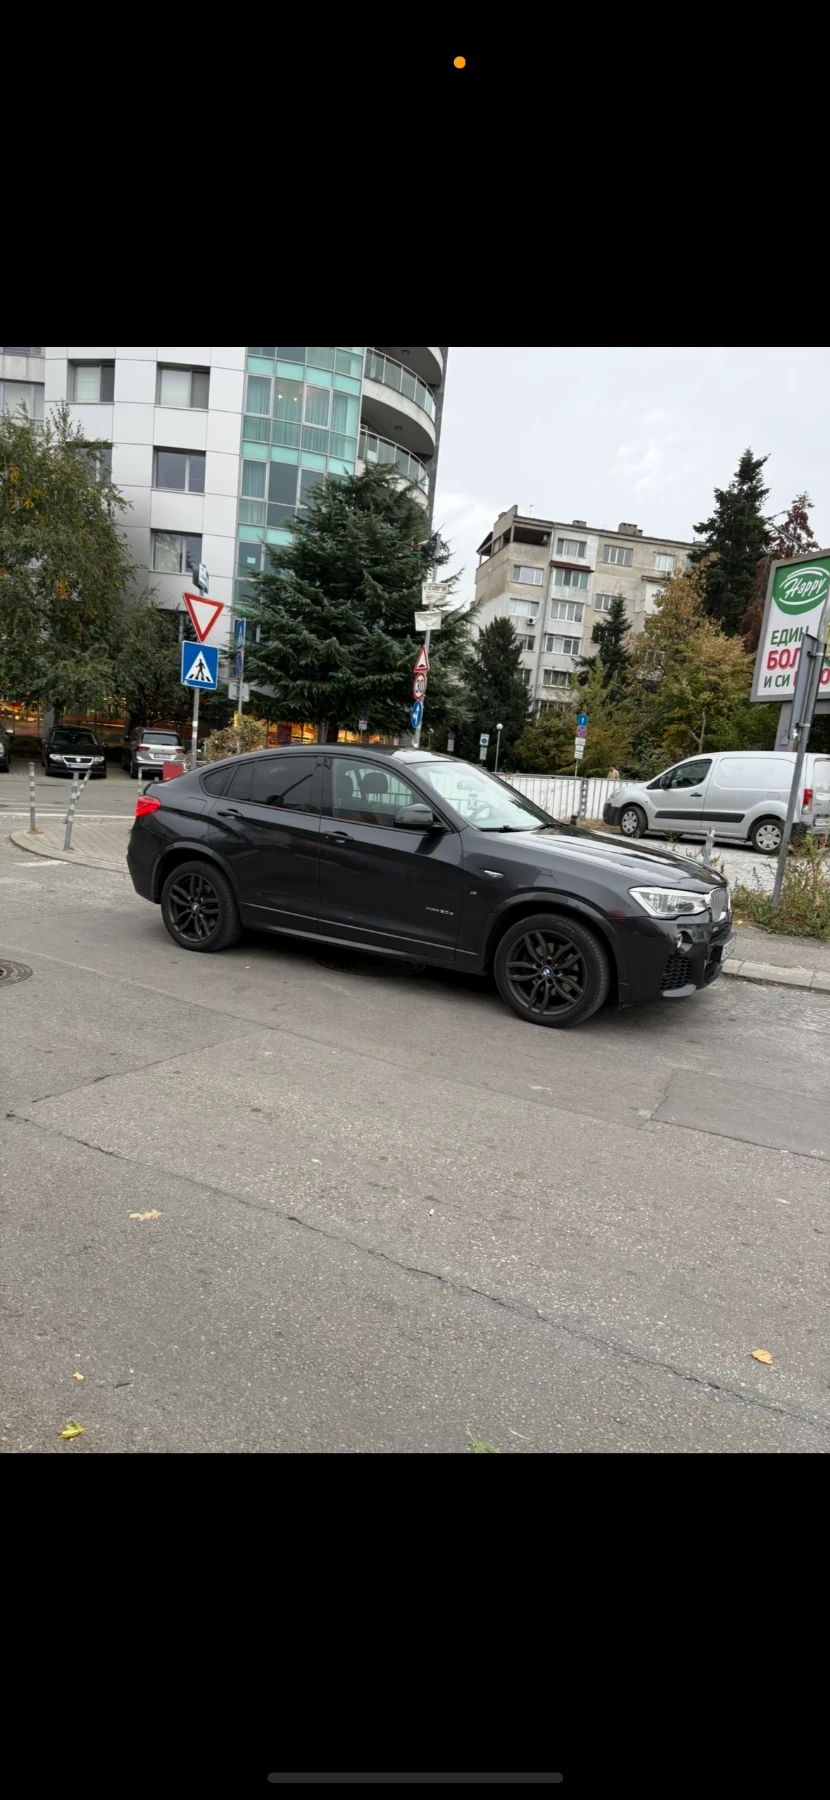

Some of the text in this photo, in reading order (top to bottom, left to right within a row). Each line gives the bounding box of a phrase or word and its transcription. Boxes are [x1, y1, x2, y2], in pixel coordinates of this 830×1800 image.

[784, 577, 827, 599] Happy
[415, 679, 424, 693] 30
[763, 676, 773, 688] И
[775, 674, 791, 687] СИ
